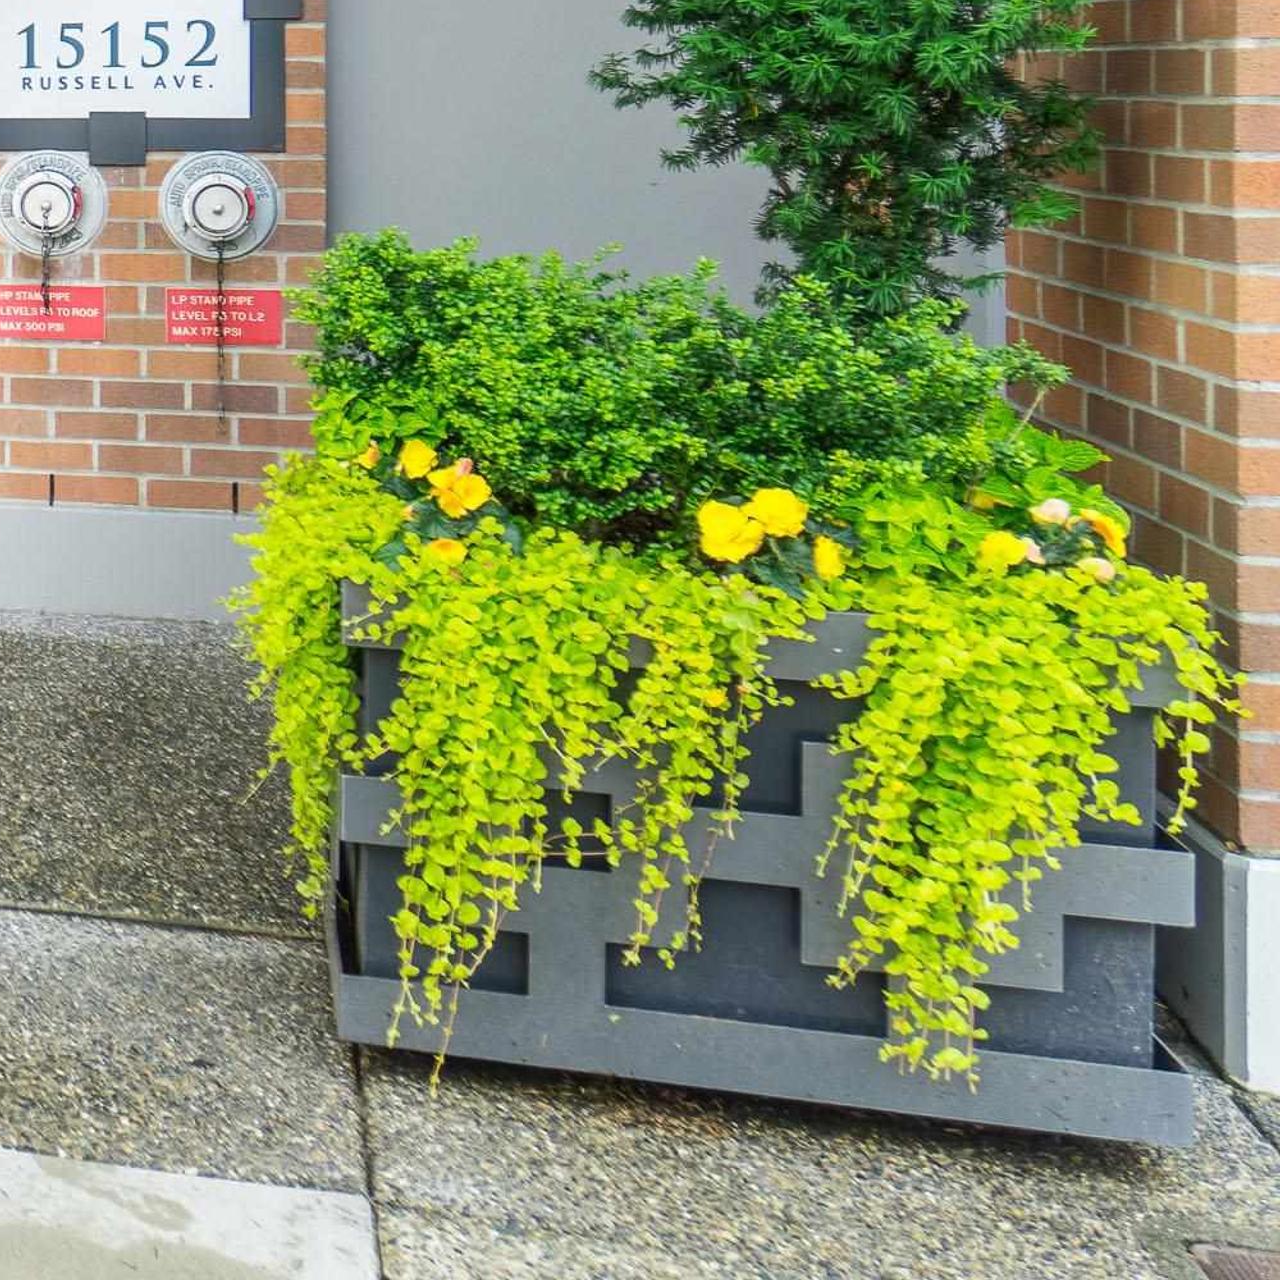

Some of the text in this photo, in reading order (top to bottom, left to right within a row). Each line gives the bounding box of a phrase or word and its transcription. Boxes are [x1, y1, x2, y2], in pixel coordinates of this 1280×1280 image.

[17, 19, 218, 69] 15152
[22, 74, 215, 90] RUSSELL AVE.
[15, 291, 48, 302] STAN
[49, 292, 71, 302] PIPE
[172, 295, 255, 306] LP STAND PIPE
[0, 306, 38, 316] LEVELS
[57, 308, 71, 317] TO
[72, 308, 100, 318] ROOF
[172, 311, 209, 321] LEVEL
[231, 312, 247, 322] TO
[249, 313, 265, 322] L2
[0, 322, 21, 331] MAX
[172, 326, 198, 336] MAX
[223, 327, 242, 338] PSI
